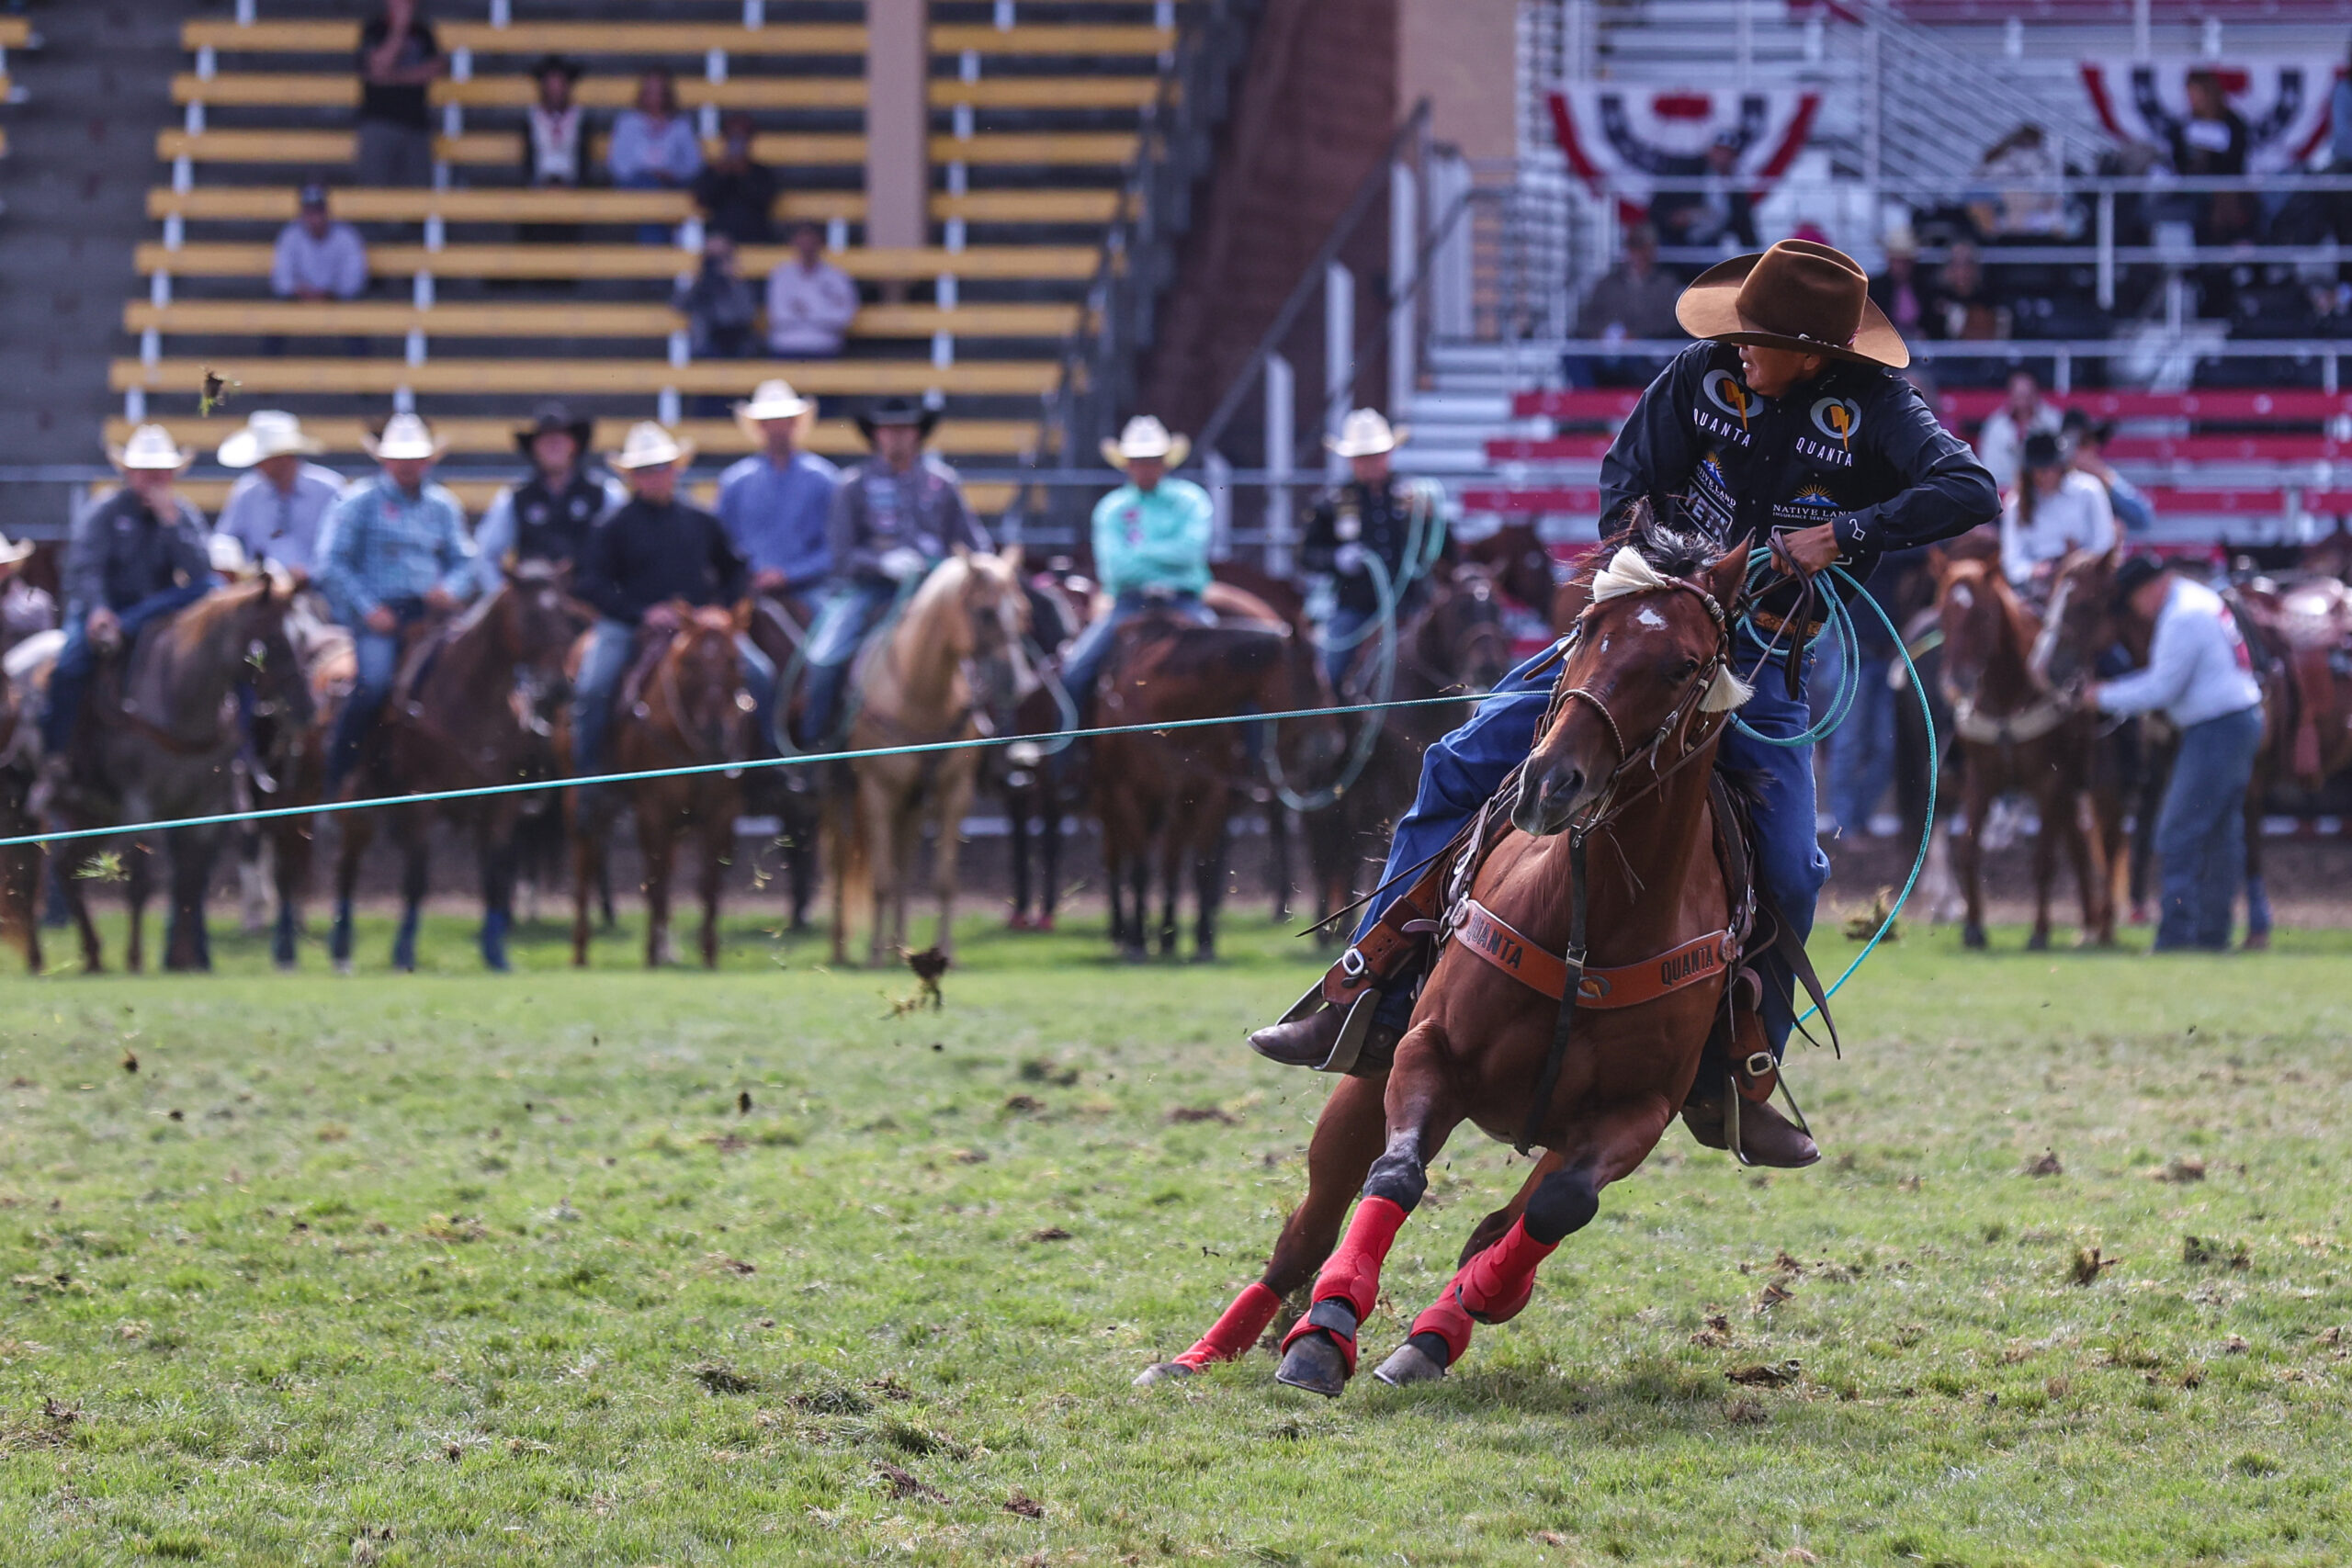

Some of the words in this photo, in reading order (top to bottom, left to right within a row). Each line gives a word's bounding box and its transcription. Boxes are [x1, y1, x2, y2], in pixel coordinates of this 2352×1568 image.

[1693, 408, 1751, 447] QUANTA
[1796, 436, 1852, 467] QUANTA
[1715, 484, 1736, 506] LAND
[1772, 503, 1818, 516] NATIVE
[1822, 510, 1852, 518] LAN
[1772, 512, 1806, 520] INSURANCE
[1466, 913, 1523, 969] QUANTA
[1661, 944, 1714, 986] QUANTA
